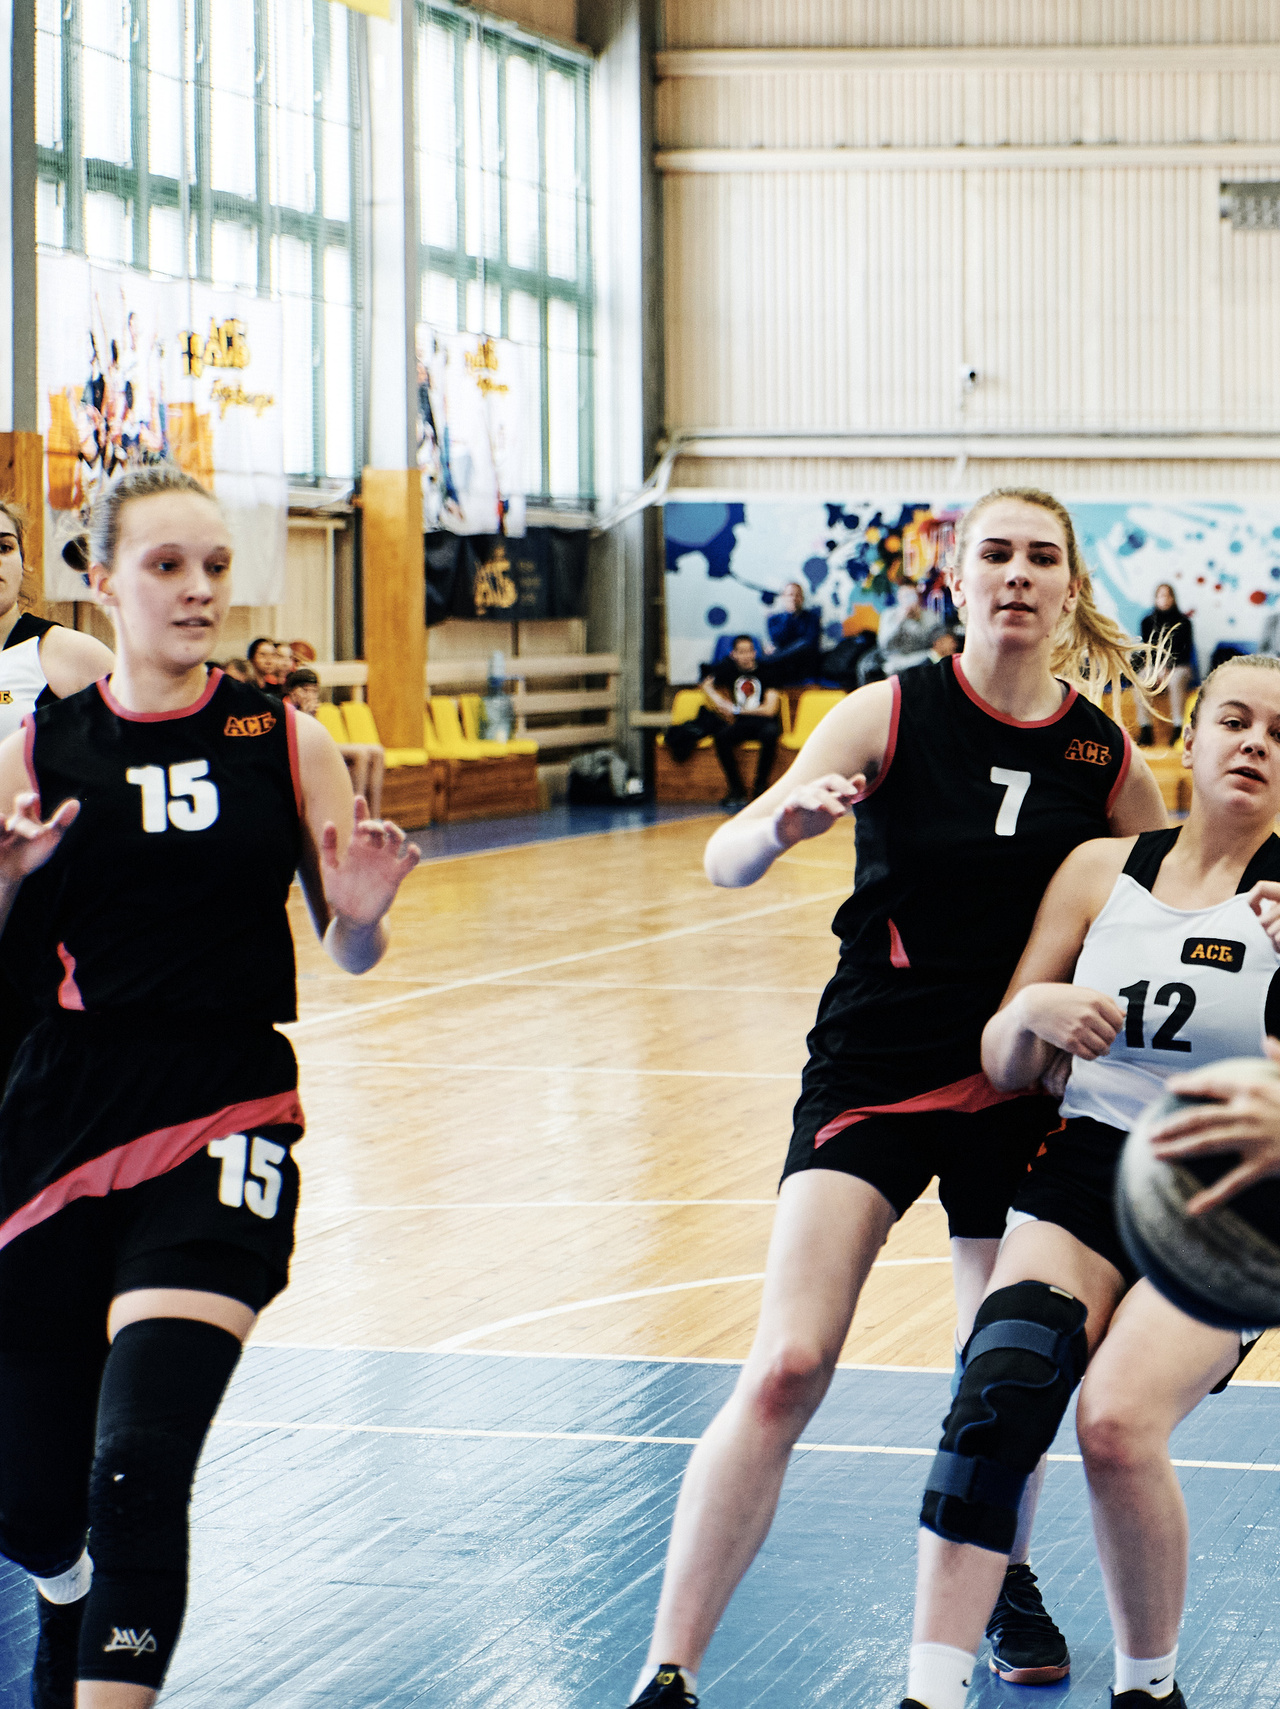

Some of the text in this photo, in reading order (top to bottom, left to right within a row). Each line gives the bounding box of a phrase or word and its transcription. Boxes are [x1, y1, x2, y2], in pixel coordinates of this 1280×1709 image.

[125, 758, 220, 833] 15
[990, 766, 1031, 836] 7
[1118, 979, 1197, 1053] 12
[207, 1133, 287, 1220] 15
